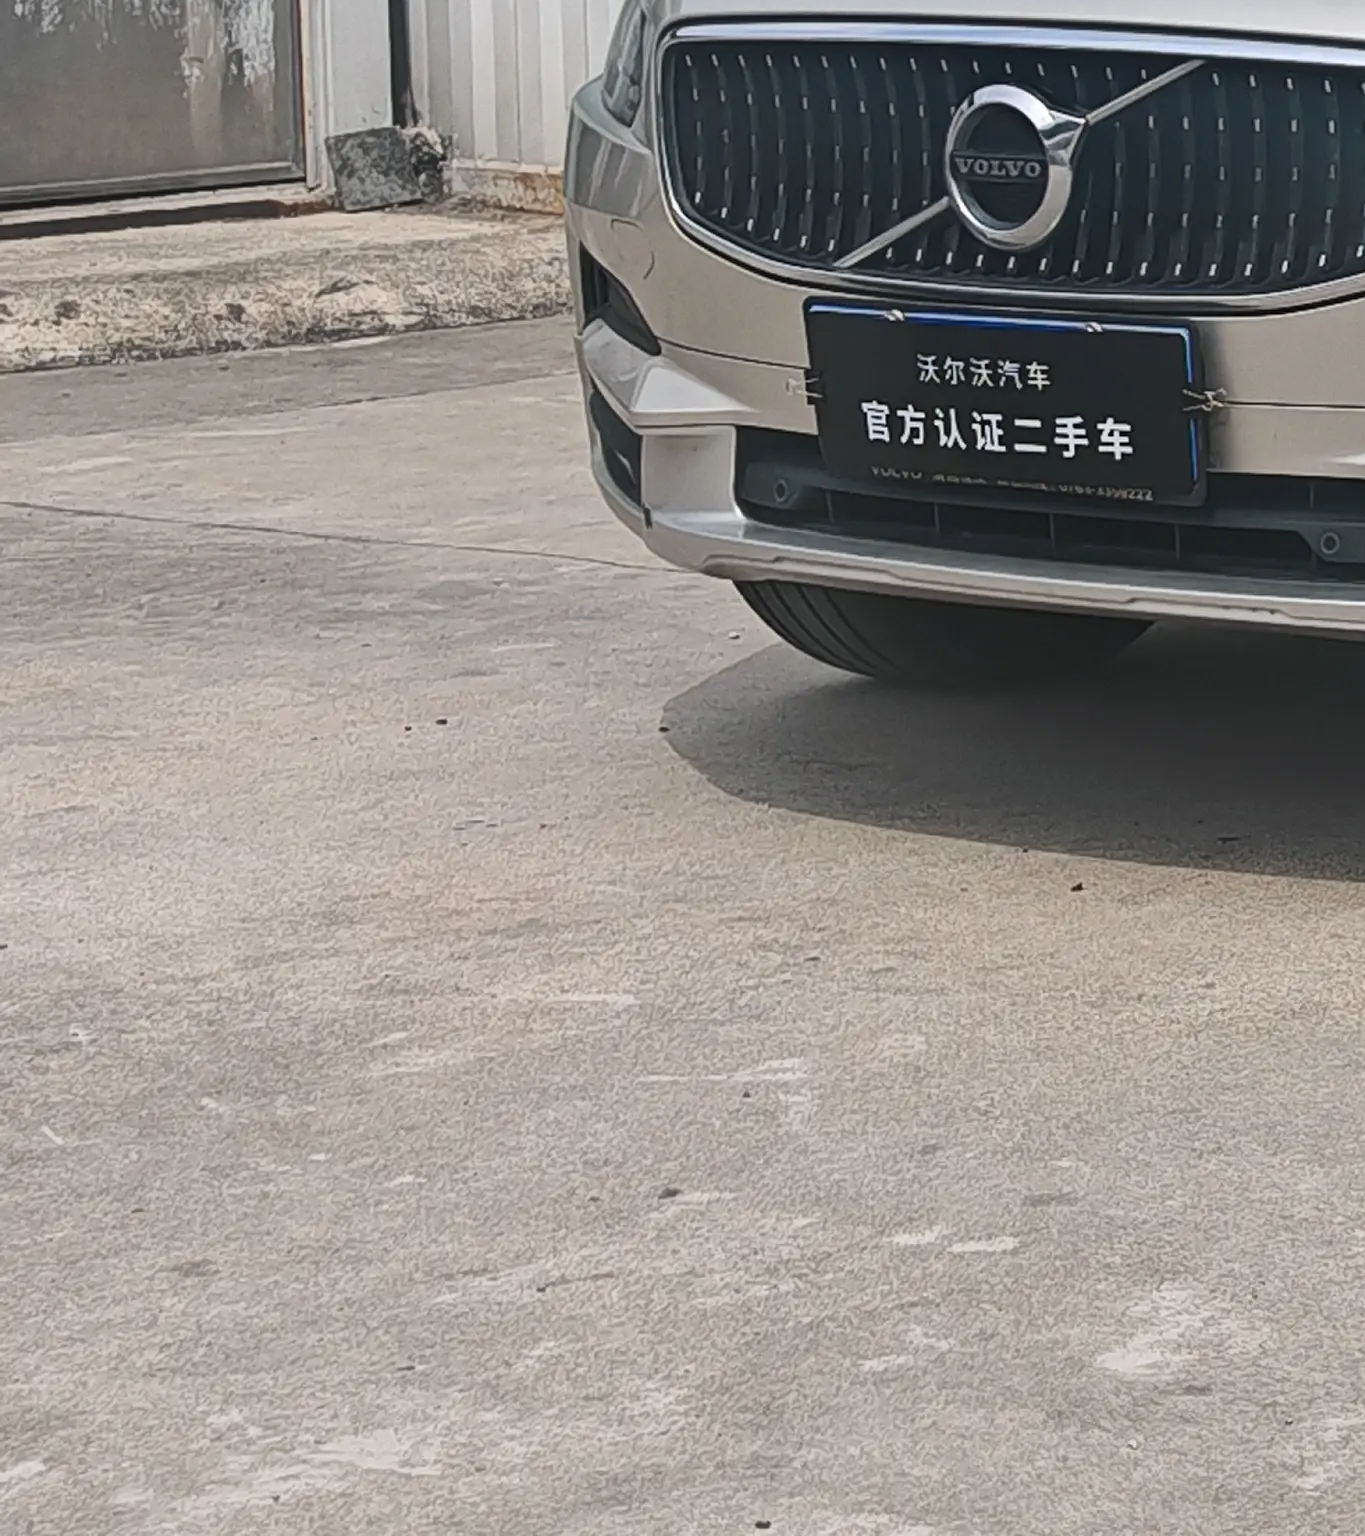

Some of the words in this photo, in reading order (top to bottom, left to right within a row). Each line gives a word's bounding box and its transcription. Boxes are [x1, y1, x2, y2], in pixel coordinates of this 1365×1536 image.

[954, 156, 1042, 179] VOLVO
[916, 353, 1052, 392] 沃尔沃汽车
[860, 400, 1135, 461] 官方认证二手车
